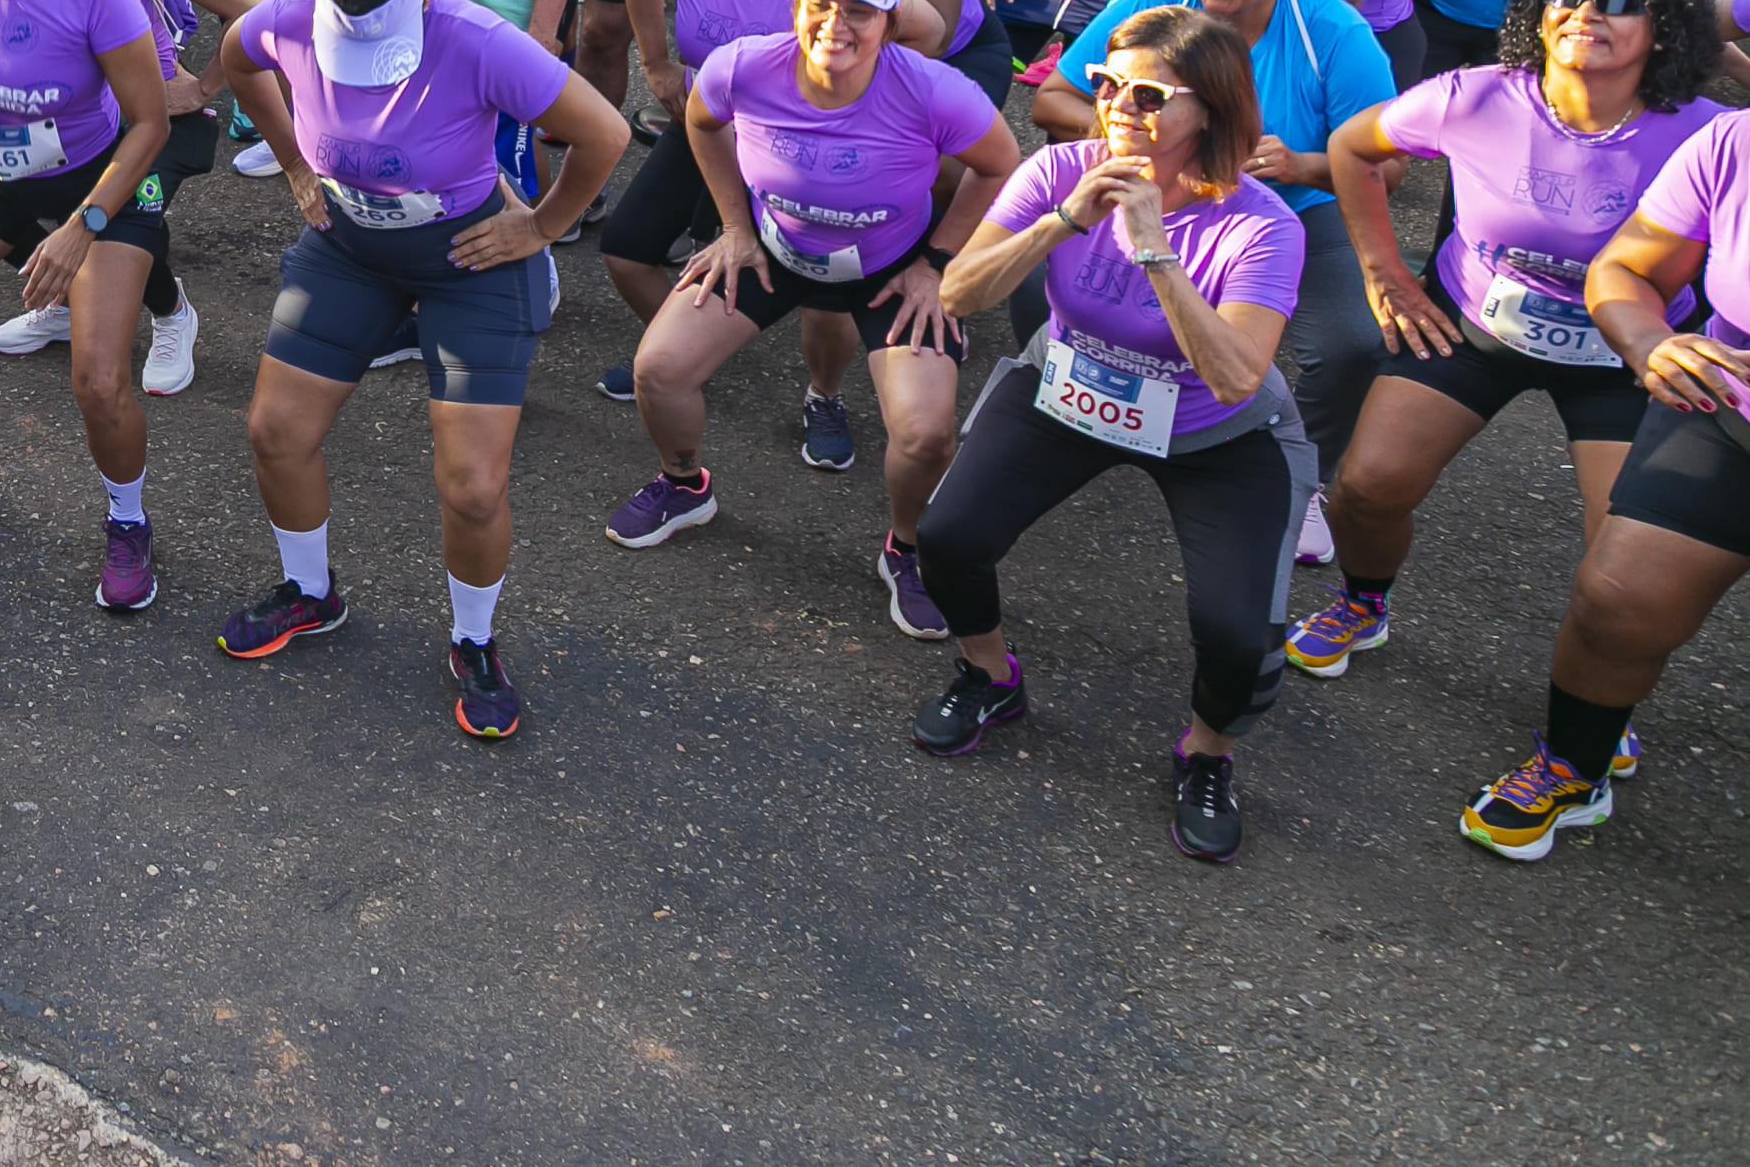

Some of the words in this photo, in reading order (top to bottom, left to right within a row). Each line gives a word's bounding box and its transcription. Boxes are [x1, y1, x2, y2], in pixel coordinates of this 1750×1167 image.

[516, 124, 529, 152] NIKE
[315, 146, 361, 174] RUN
[1512, 177, 1576, 209] RUN
[352, 203, 407, 222] 260
[767, 194, 888, 223] CELEBRAR
[1074, 269, 1129, 297] RUN
[1523, 320, 1588, 350] 301
[1071, 329, 1196, 375] CELEBRAR
[1071, 340, 1174, 381] CORRIDA
[1058, 382, 1144, 432] 2005
